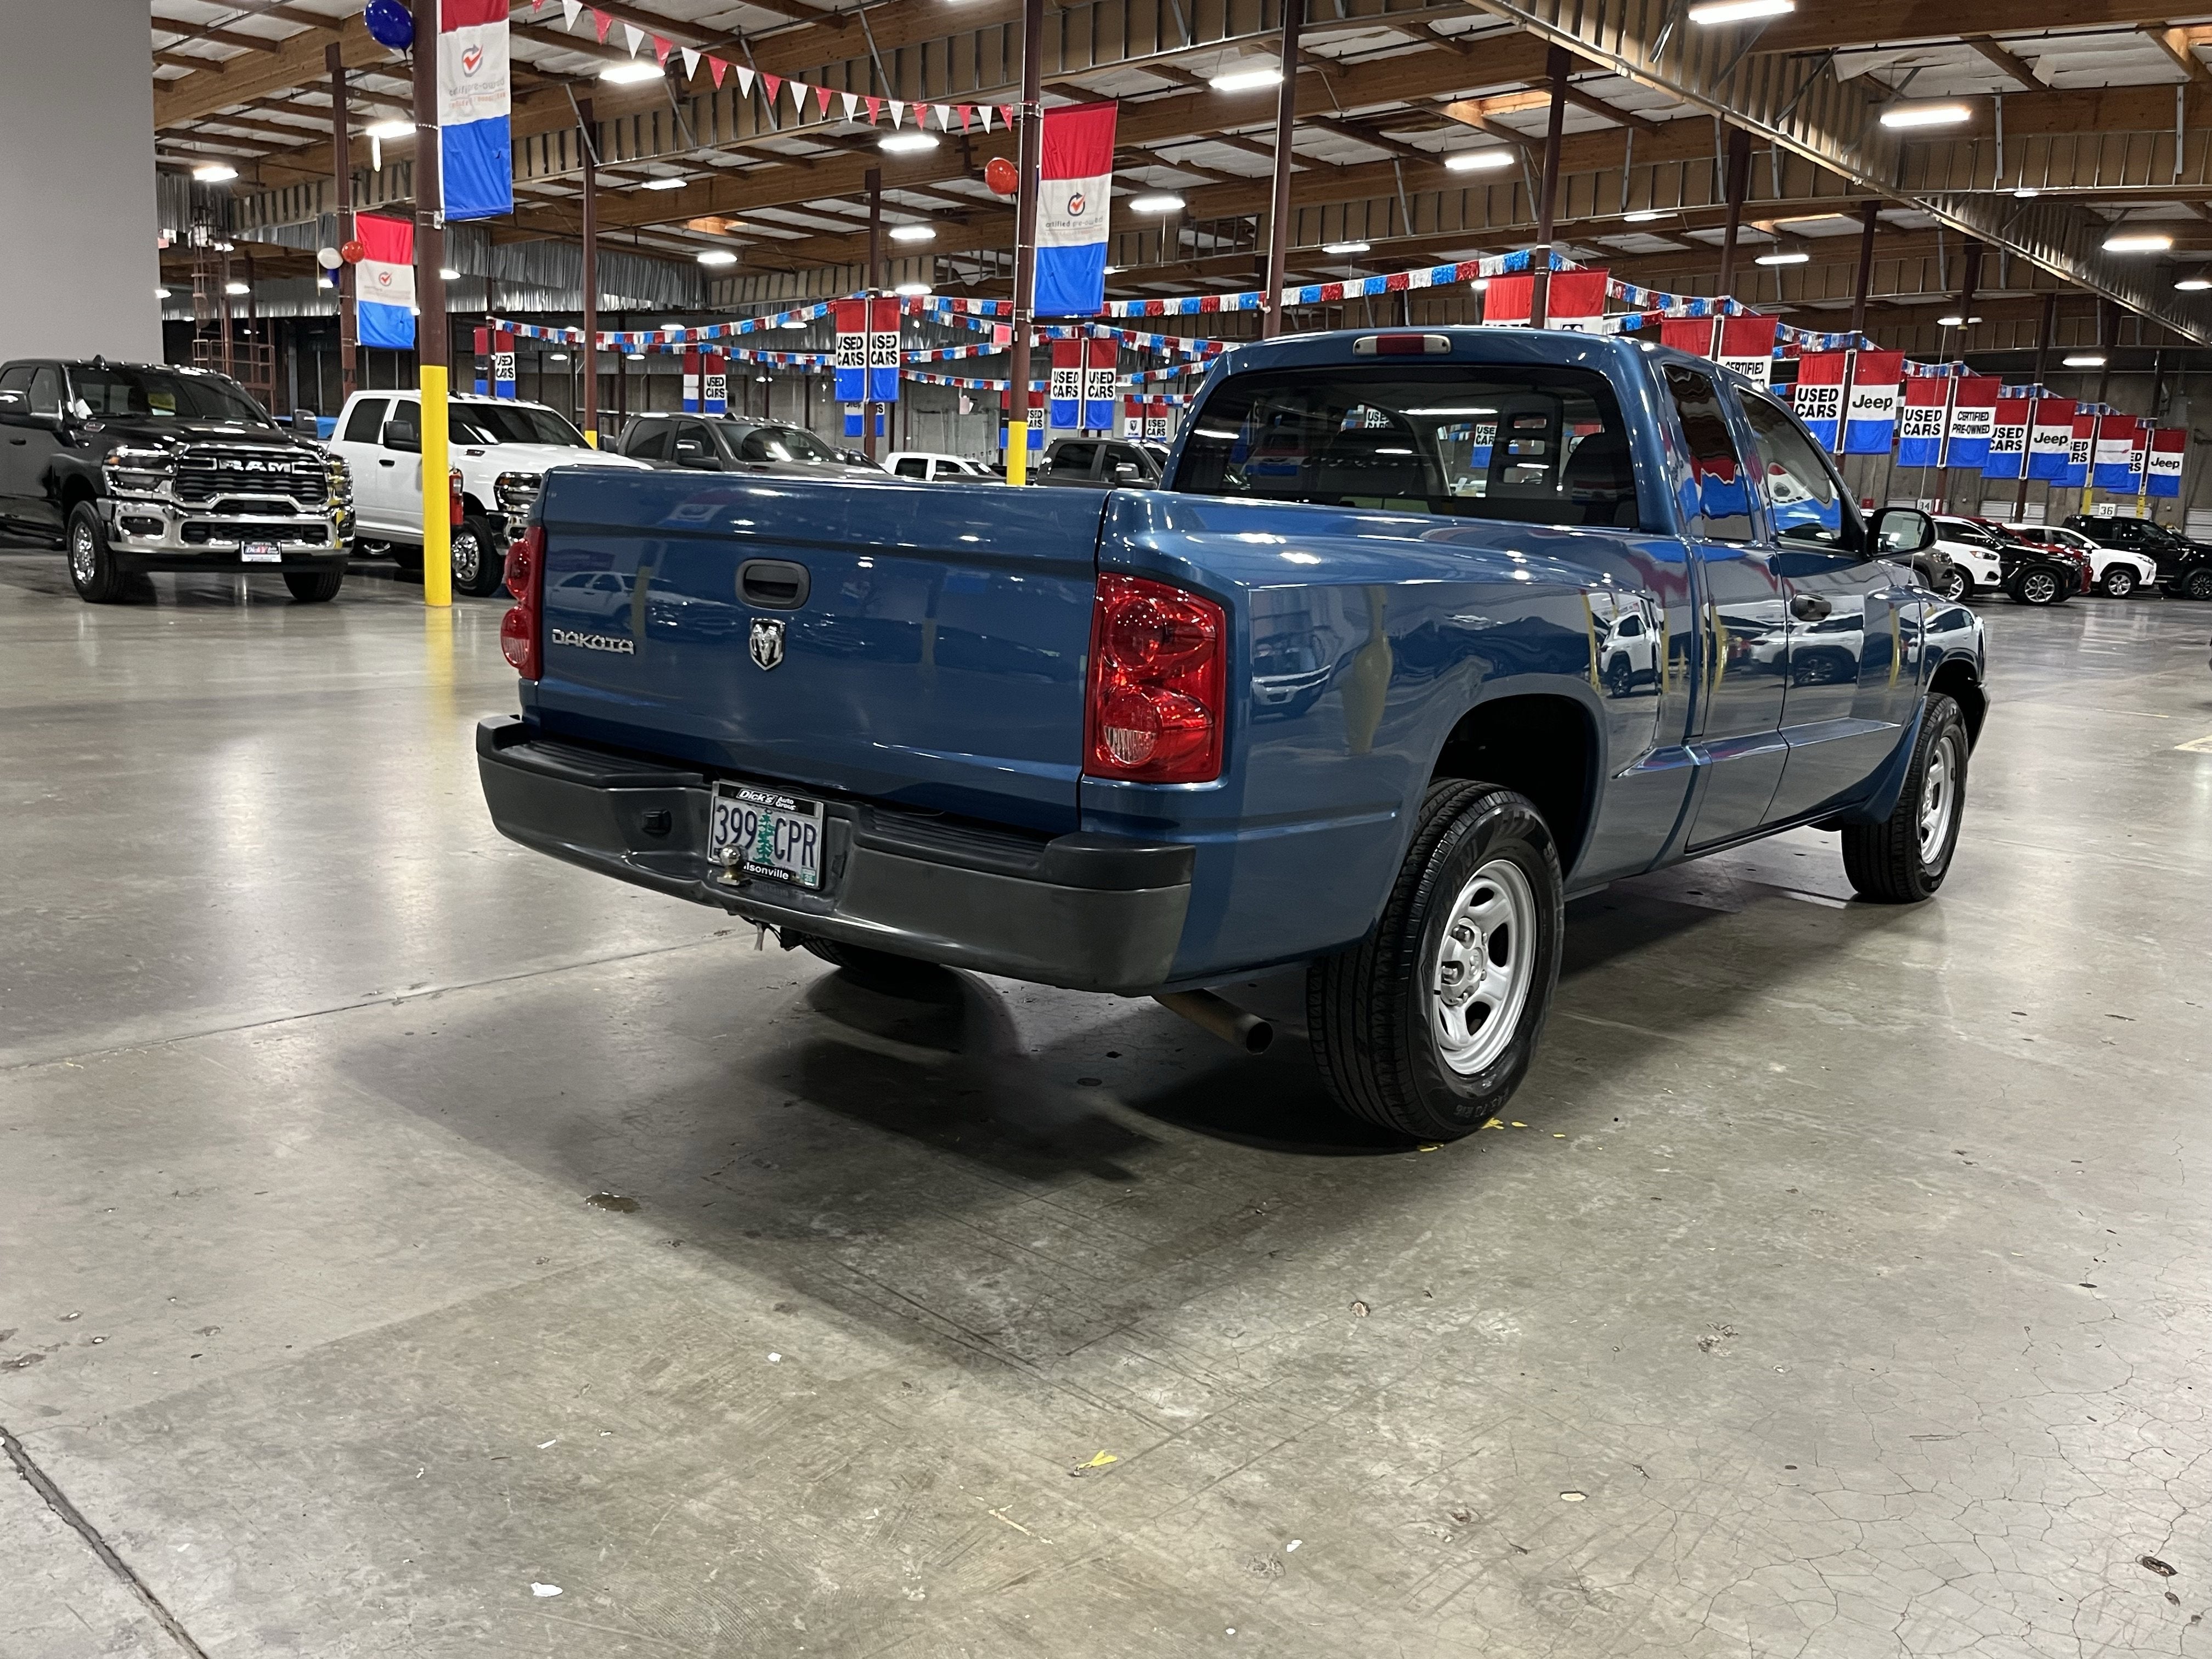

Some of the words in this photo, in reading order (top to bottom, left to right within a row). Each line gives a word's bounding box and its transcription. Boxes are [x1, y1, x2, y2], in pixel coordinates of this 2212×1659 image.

[837, 336, 864, 350] USED
[872, 335, 897, 349] USED
[837, 352, 865, 366] CARS
[871, 351, 897, 365] CARS
[707, 377, 724, 386] USED
[1054, 371, 1079, 383] USED
[1089, 371, 1114, 384] USED
[1053, 385, 1079, 398] CARS
[1088, 386, 1114, 398] CARS
[1797, 388, 1838, 402] USED
[1852, 394, 1893, 411] Jeep
[1029, 410, 1042, 419] SED
[1368, 411, 1389, 421] USE
[1795, 404, 1837, 418] CARS
[1905, 409, 1942, 422] USED
[1957, 411, 1989, 421] CERTIFIED
[1148, 419, 1166, 427] USED
[1147, 428, 1165, 437] CARS
[1477, 426, 1495, 435] USE
[1904, 424, 1940, 436] CARS
[1952, 424, 1990, 435] PRE-OWNED
[1476, 435, 1494, 445] CAR
[1990, 440, 2022, 451] CARS
[2033, 432, 2068, 447] Jeep
[2070, 442, 2089, 452] ED
[2069, 452, 2087, 462] RS
[2131, 453, 2142, 462] ED
[219, 460, 290, 472] RAM
[2151, 457, 2180, 470] Jeep
[2100, 506, 2113, 515] 36
[552, 629, 634, 655] DAKOTA
[739, 790, 773, 803] Dick's
[778, 796, 794, 804] Auto
[715, 805, 757, 849] 399
[774, 817, 816, 867] CPR
[743, 862, 789, 879] lsonville
